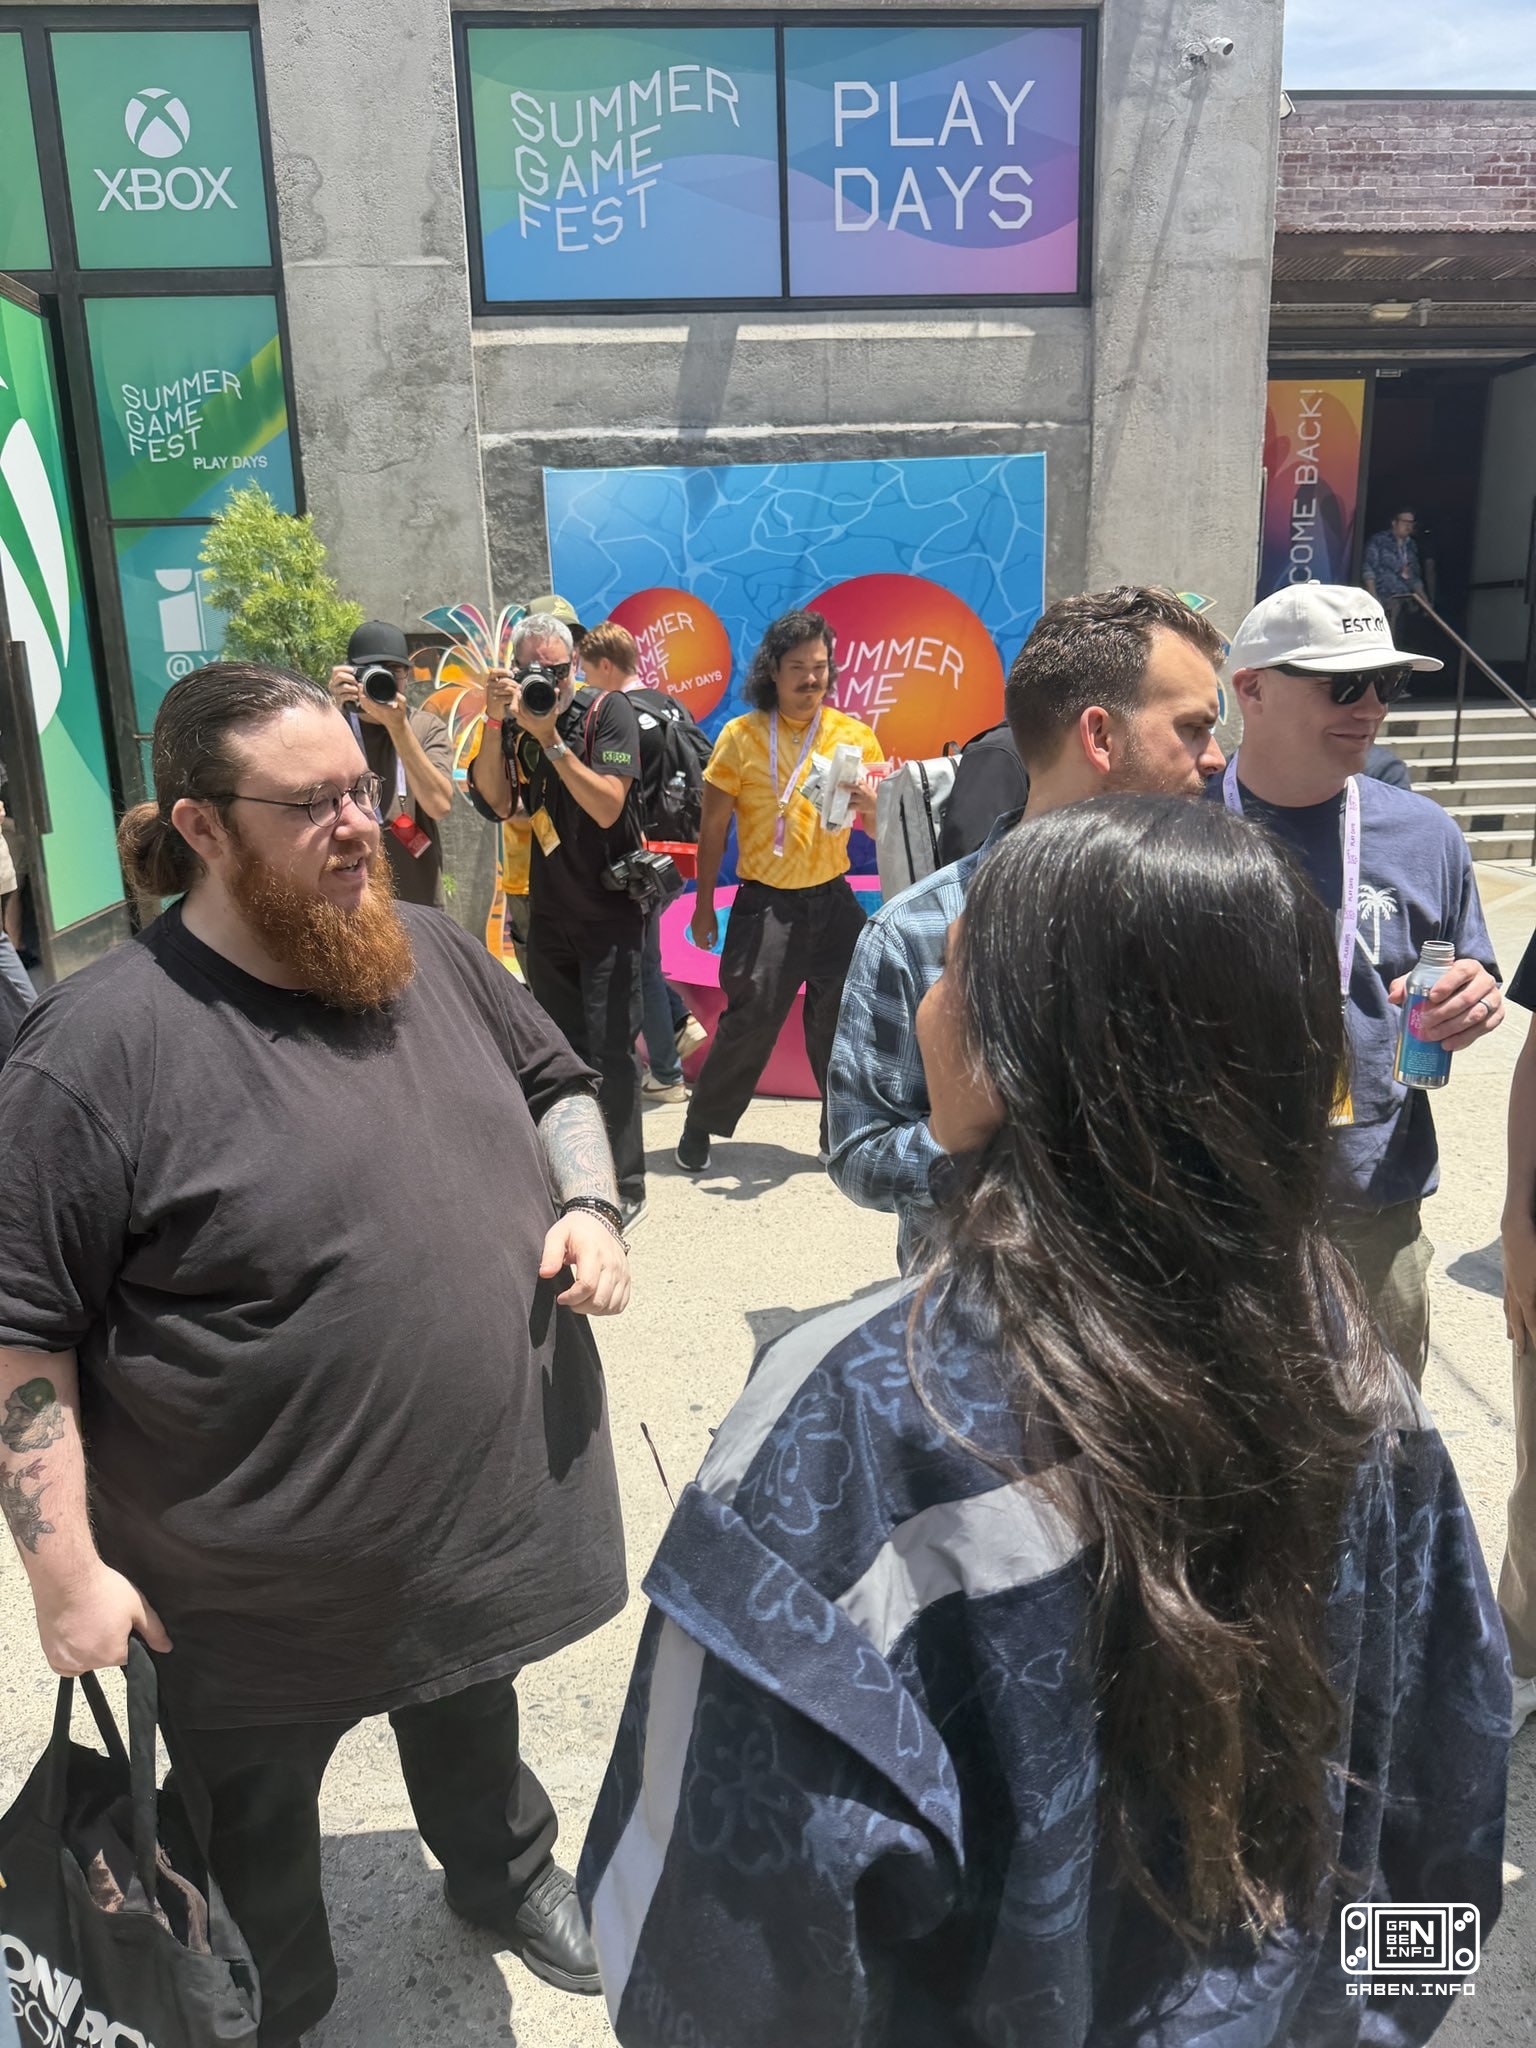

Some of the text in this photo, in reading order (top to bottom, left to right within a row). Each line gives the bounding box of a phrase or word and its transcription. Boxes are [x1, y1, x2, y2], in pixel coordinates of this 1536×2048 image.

[510, 64, 742, 149] SUMMER
[834, 80, 1037, 147] PLAY
[514, 124, 663, 200] GAME
[94, 167, 237, 212] XBOX
[834, 165, 1034, 232] DAYS
[518, 178, 658, 253] FEST
[121, 369, 243, 411] SUMMER
[126, 399, 204, 438] GAME
[1293, 388, 1323, 486] BACK!
[129, 426, 201, 464] FEST
[193, 455, 268, 470] PLAY DAYS
[635, 611, 696, 654] MMER
[666, 670, 723, 695] PLAY DAYS
[832, 637, 965, 690] UMMER
